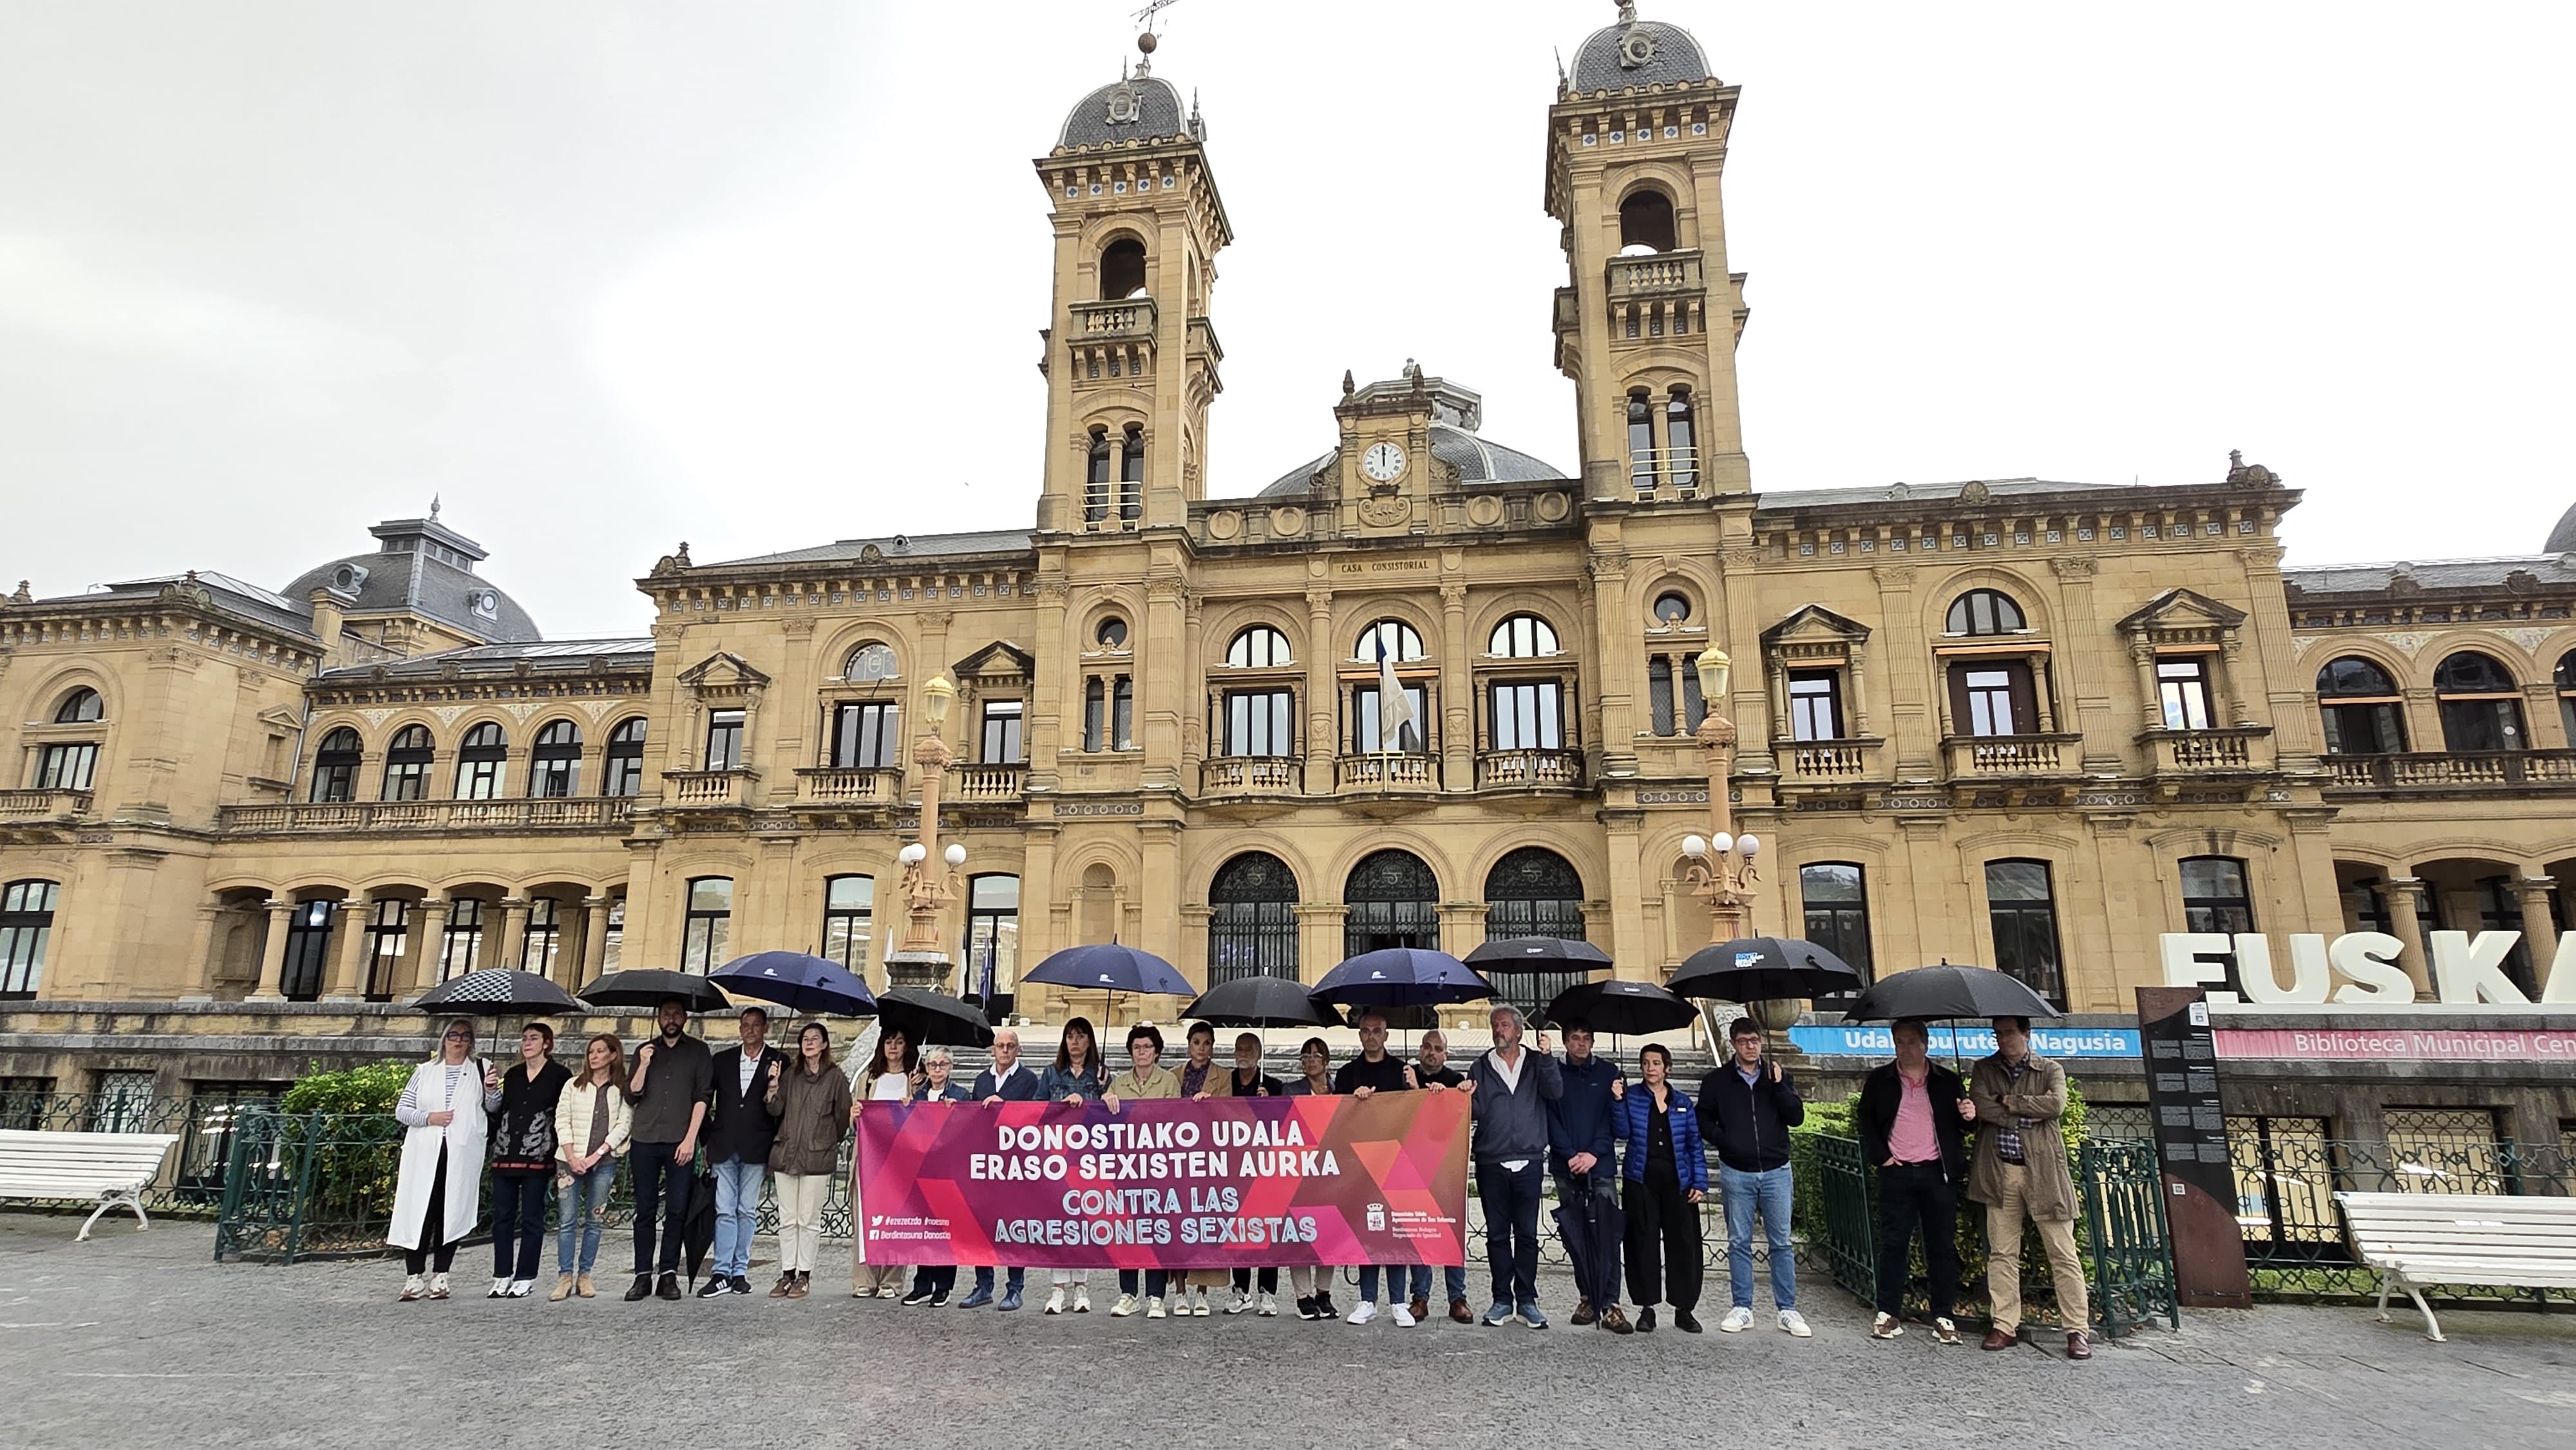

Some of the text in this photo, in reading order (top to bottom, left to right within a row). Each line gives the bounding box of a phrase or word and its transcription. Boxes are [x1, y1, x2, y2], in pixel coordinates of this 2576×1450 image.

[1341, 560, 1429, 573] CASA CONSISTORIAL
[2030, 1033, 2126, 1055] Nagusia
[2295, 1034, 2576, 1056] Biblioteca Municipal Cen
[999, 1120, 1304, 1151] DONOSTIAKO UDALA
[970, 1150, 1340, 1181] ERASO SEXISTEN AURKA
[1062, 1187, 1239, 1216] CONTRA LAS
[995, 1216, 1318, 1245] AGRESIONES SEXISTAS
